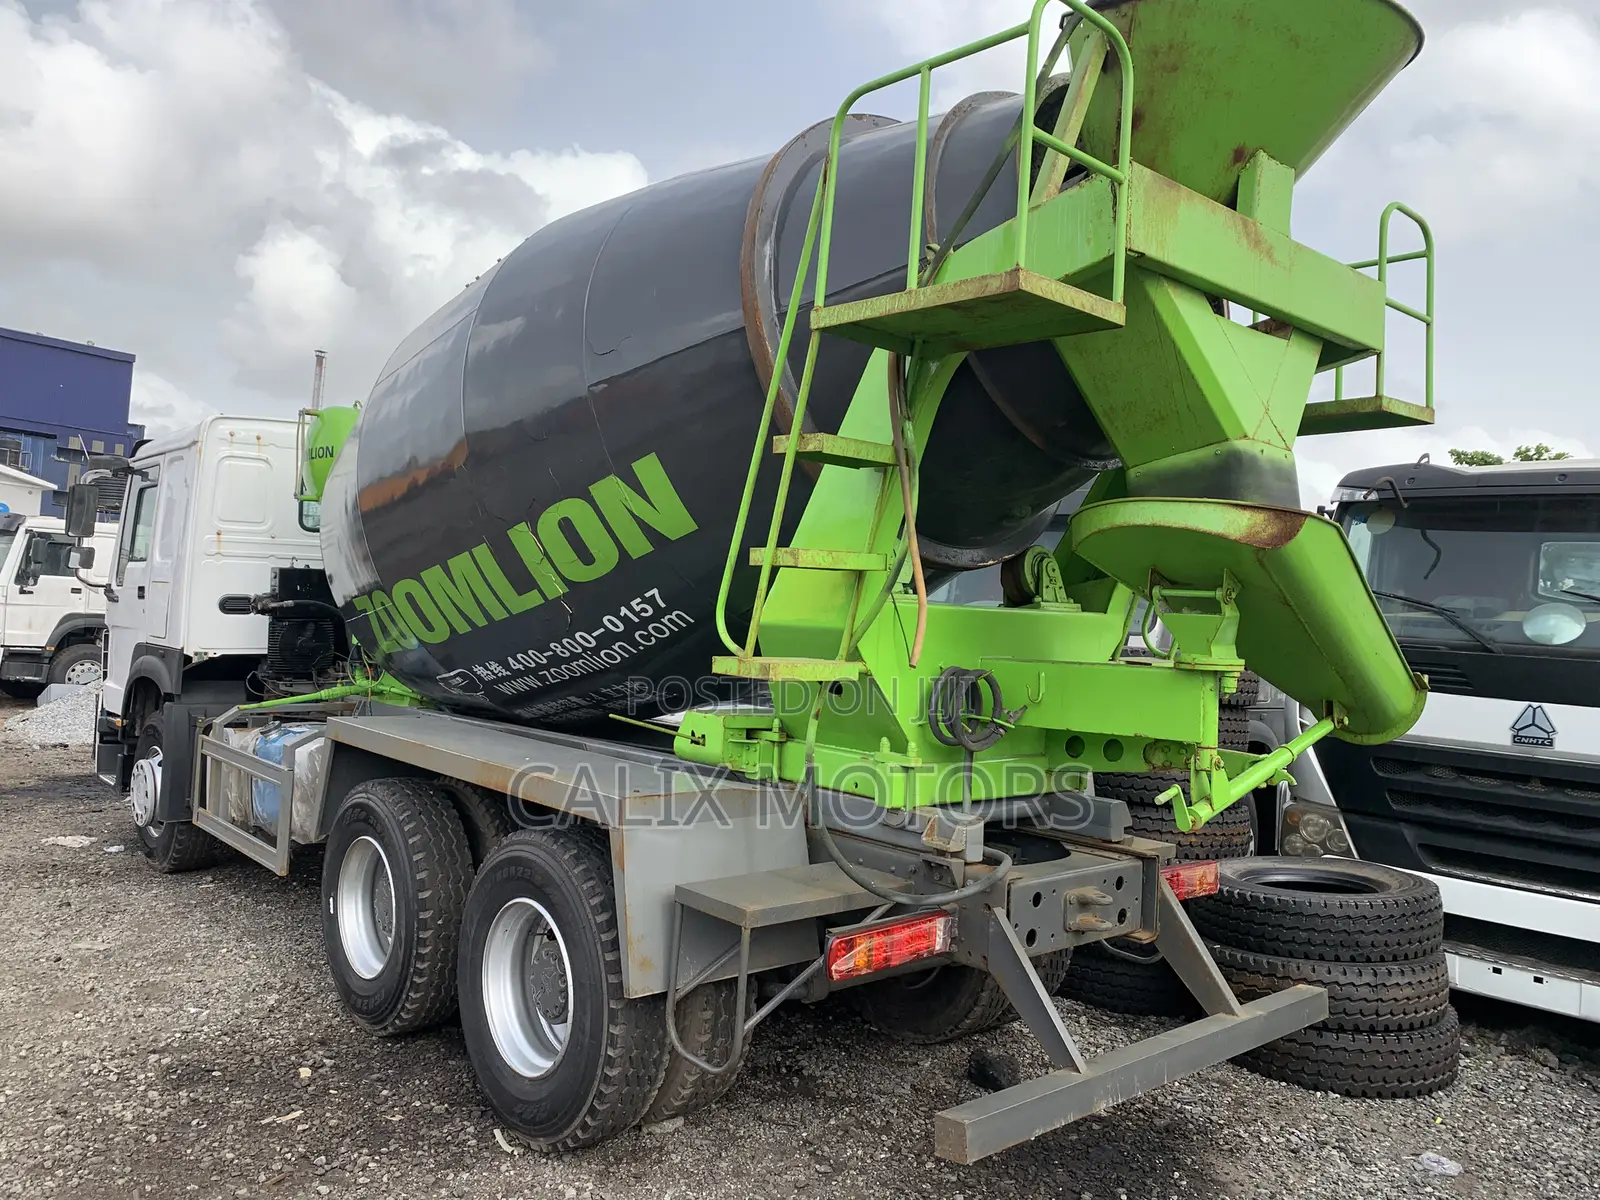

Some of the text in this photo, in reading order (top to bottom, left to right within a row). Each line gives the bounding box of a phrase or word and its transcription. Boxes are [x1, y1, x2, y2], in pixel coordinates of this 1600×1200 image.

[309, 446, 334, 460] LION
[353, 452, 699, 654] ZOOMLION
[493, 609, 695, 695] www.zoomlion.com
[507, 587, 667, 671] 400-800-0157
[1514, 736, 1552, 745] CNHTC
